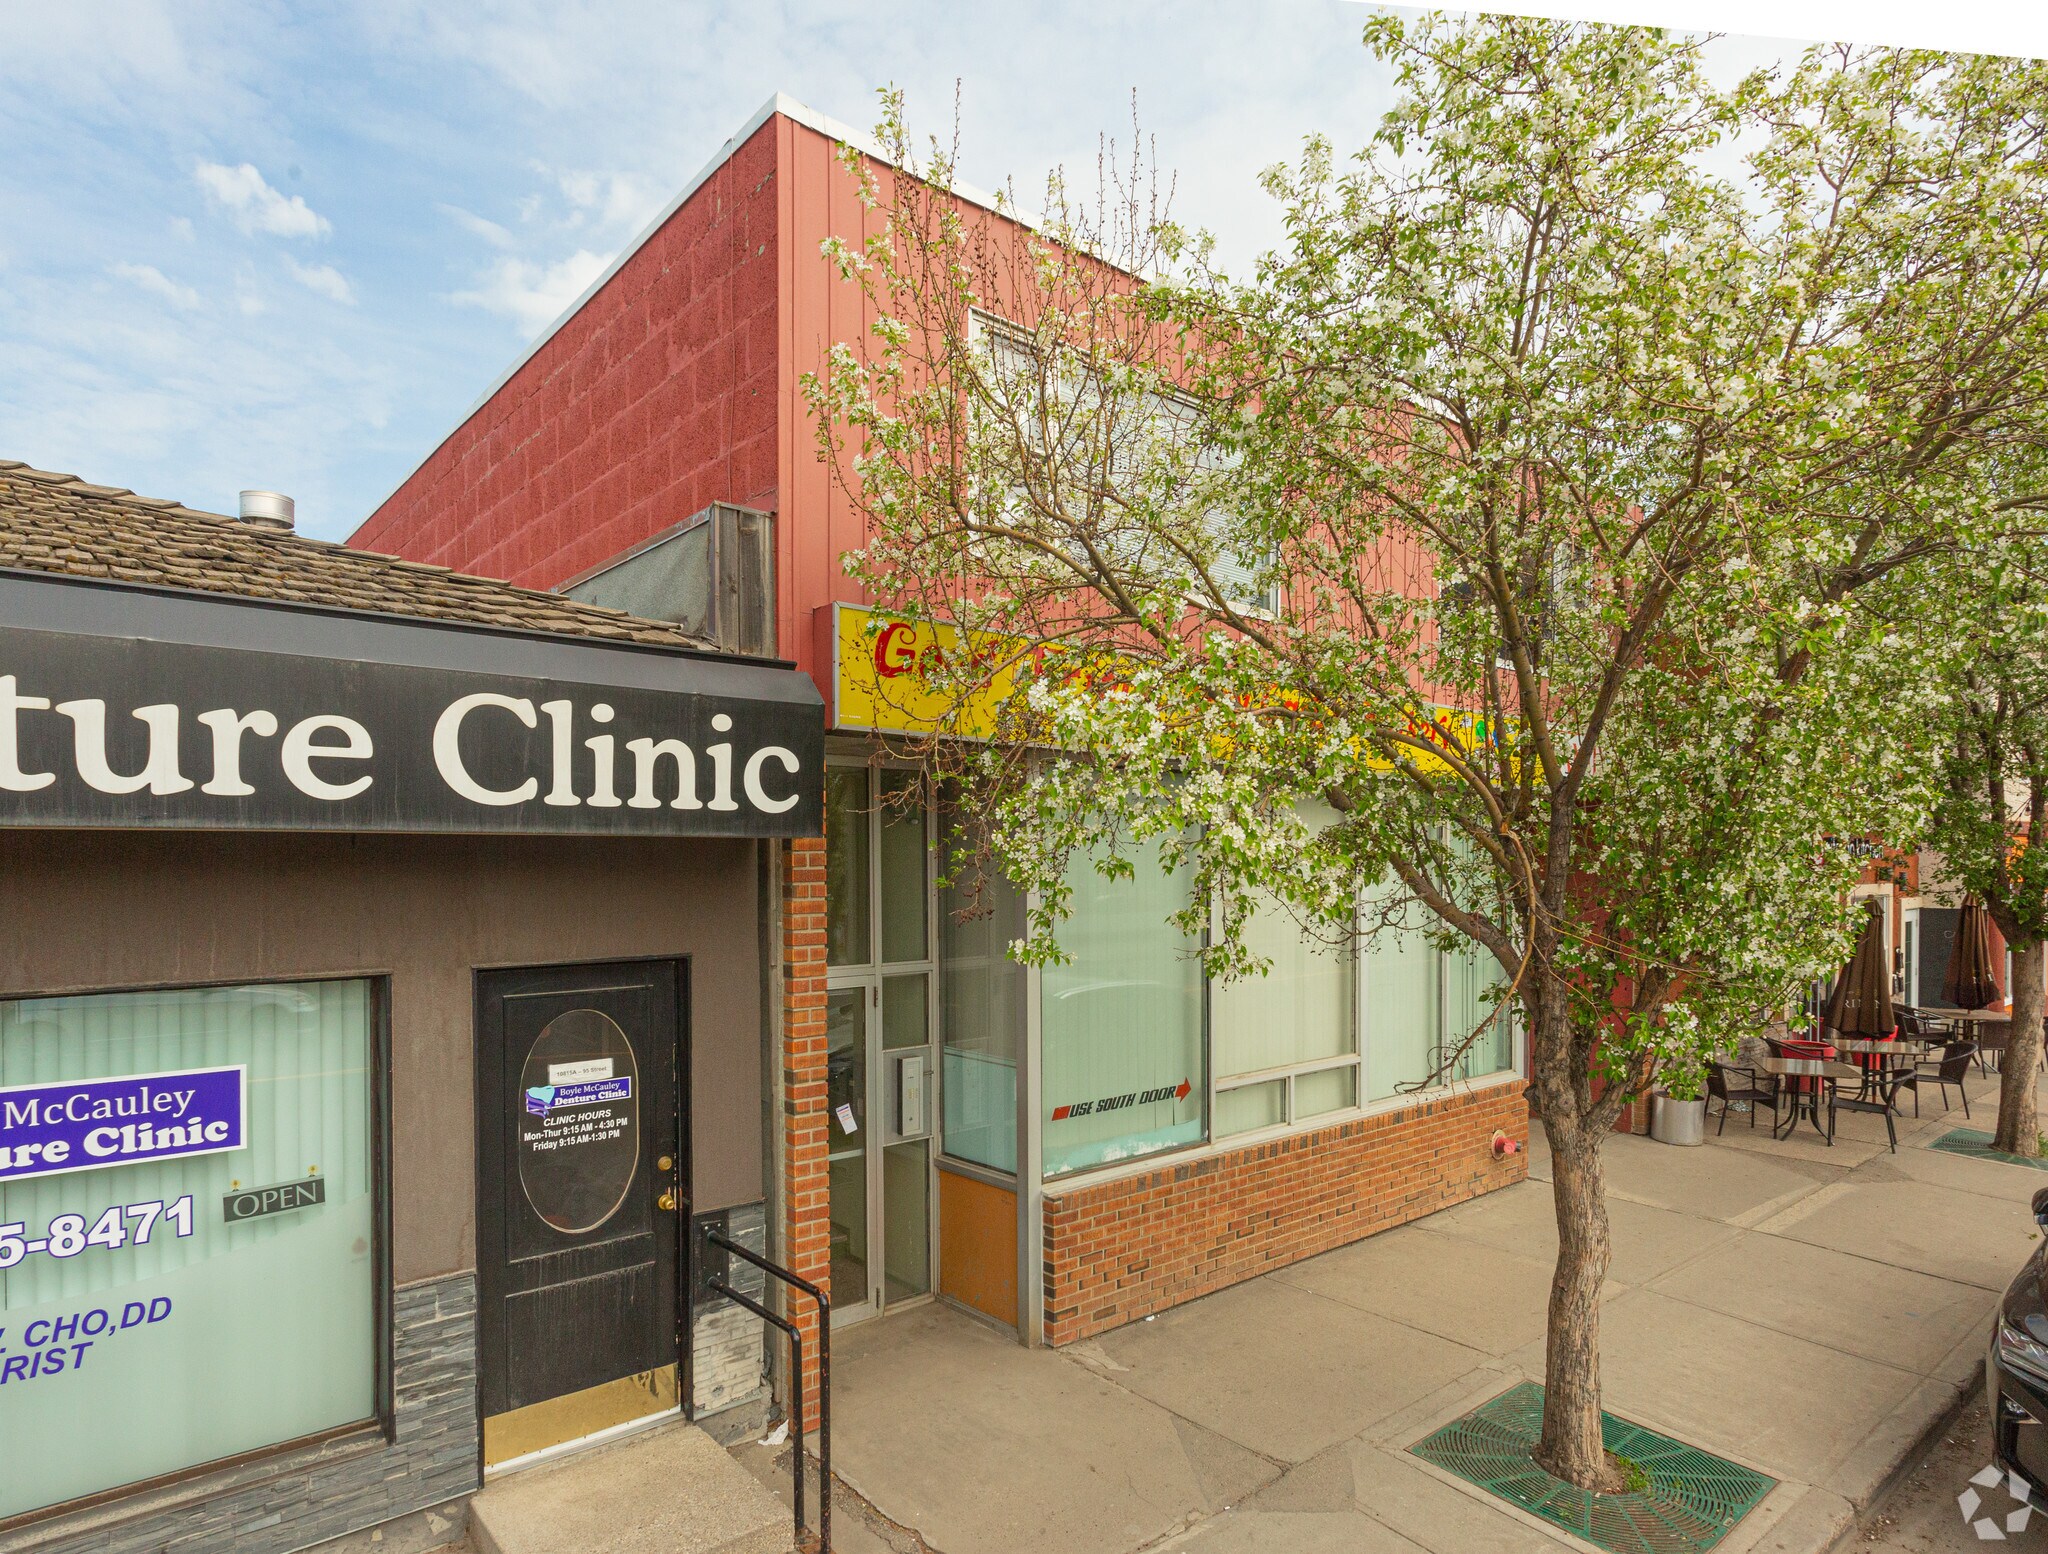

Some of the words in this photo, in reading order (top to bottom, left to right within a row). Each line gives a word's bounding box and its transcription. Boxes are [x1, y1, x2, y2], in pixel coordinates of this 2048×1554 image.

[433, 692, 801, 814] Clinic
[555, 1092, 597, 1106] Denture
[598, 1089, 627, 1100] Clinic
[560, 1086, 582, 1097] Boyle
[583, 1081, 621, 1093] McCauley
[1069, 1101, 1094, 1118] USE
[1096, 1093, 1137, 1113] SOUTH
[1139, 1085, 1177, 1105] DOOR
[3, 1086, 196, 1130] McCauley
[543, 1114, 576, 1127] CLINIC
[577, 1109, 612, 1122] HOURS
[83, 1116, 230, 1158] Clinic
[524, 1129, 562, 1142] Mon-Thur
[563, 1125, 580, 1136] 9:15
[580, 1123, 594, 1133] AM
[599, 1119, 615, 1130] 4:30
[616, 1117, 628, 1127] PM
[533, 1140, 558, 1152] Friday
[559, 1136, 576, 1147] 9:15
[608, 1129, 620, 1139] PM
[232, 1182, 318, 1218] OPEN
[0, 1194, 194, 1269] 5-8471
[24, 1296, 172, 1348] CHO,DD
[0, 1341, 95, 1386] RIST
